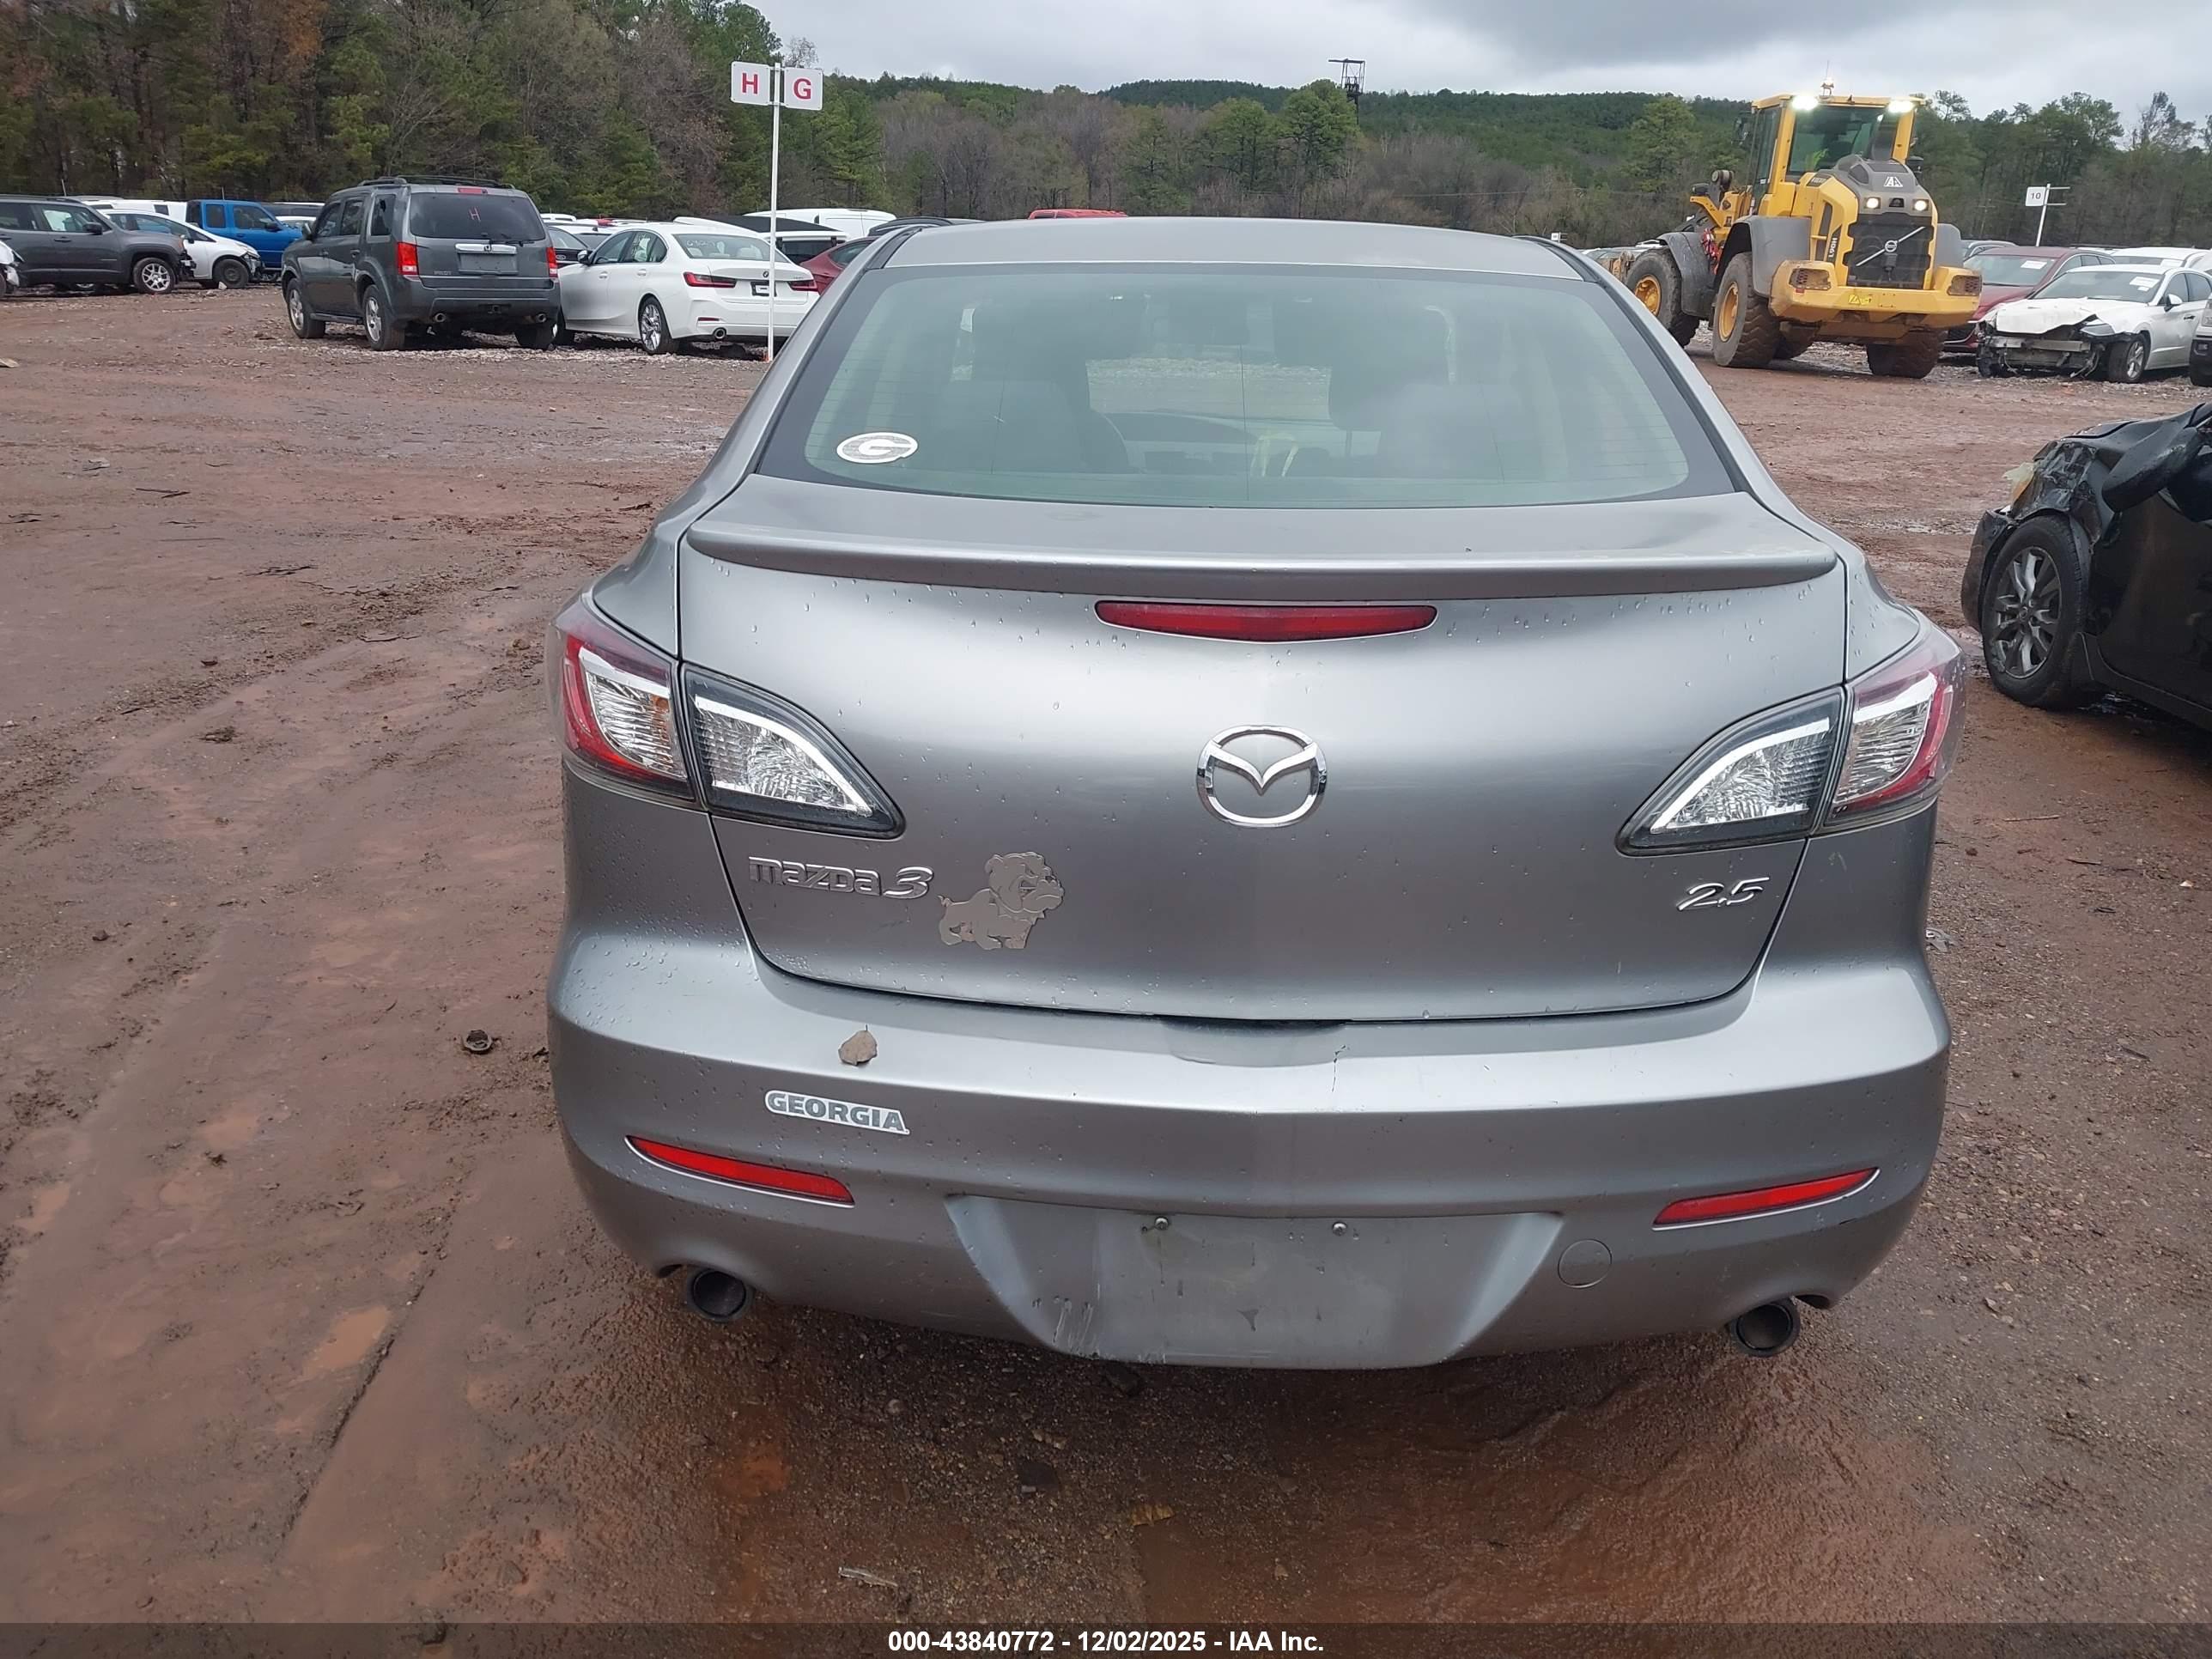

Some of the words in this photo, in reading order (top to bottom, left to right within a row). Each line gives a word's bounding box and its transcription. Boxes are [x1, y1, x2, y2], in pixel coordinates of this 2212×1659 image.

[742, 72, 758, 94] H
[793, 77, 811, 100] G
[468, 207, 481, 222] H
[1676, 877, 1770, 911] 2.5
[767, 1091, 908, 1133] GEORGIA
